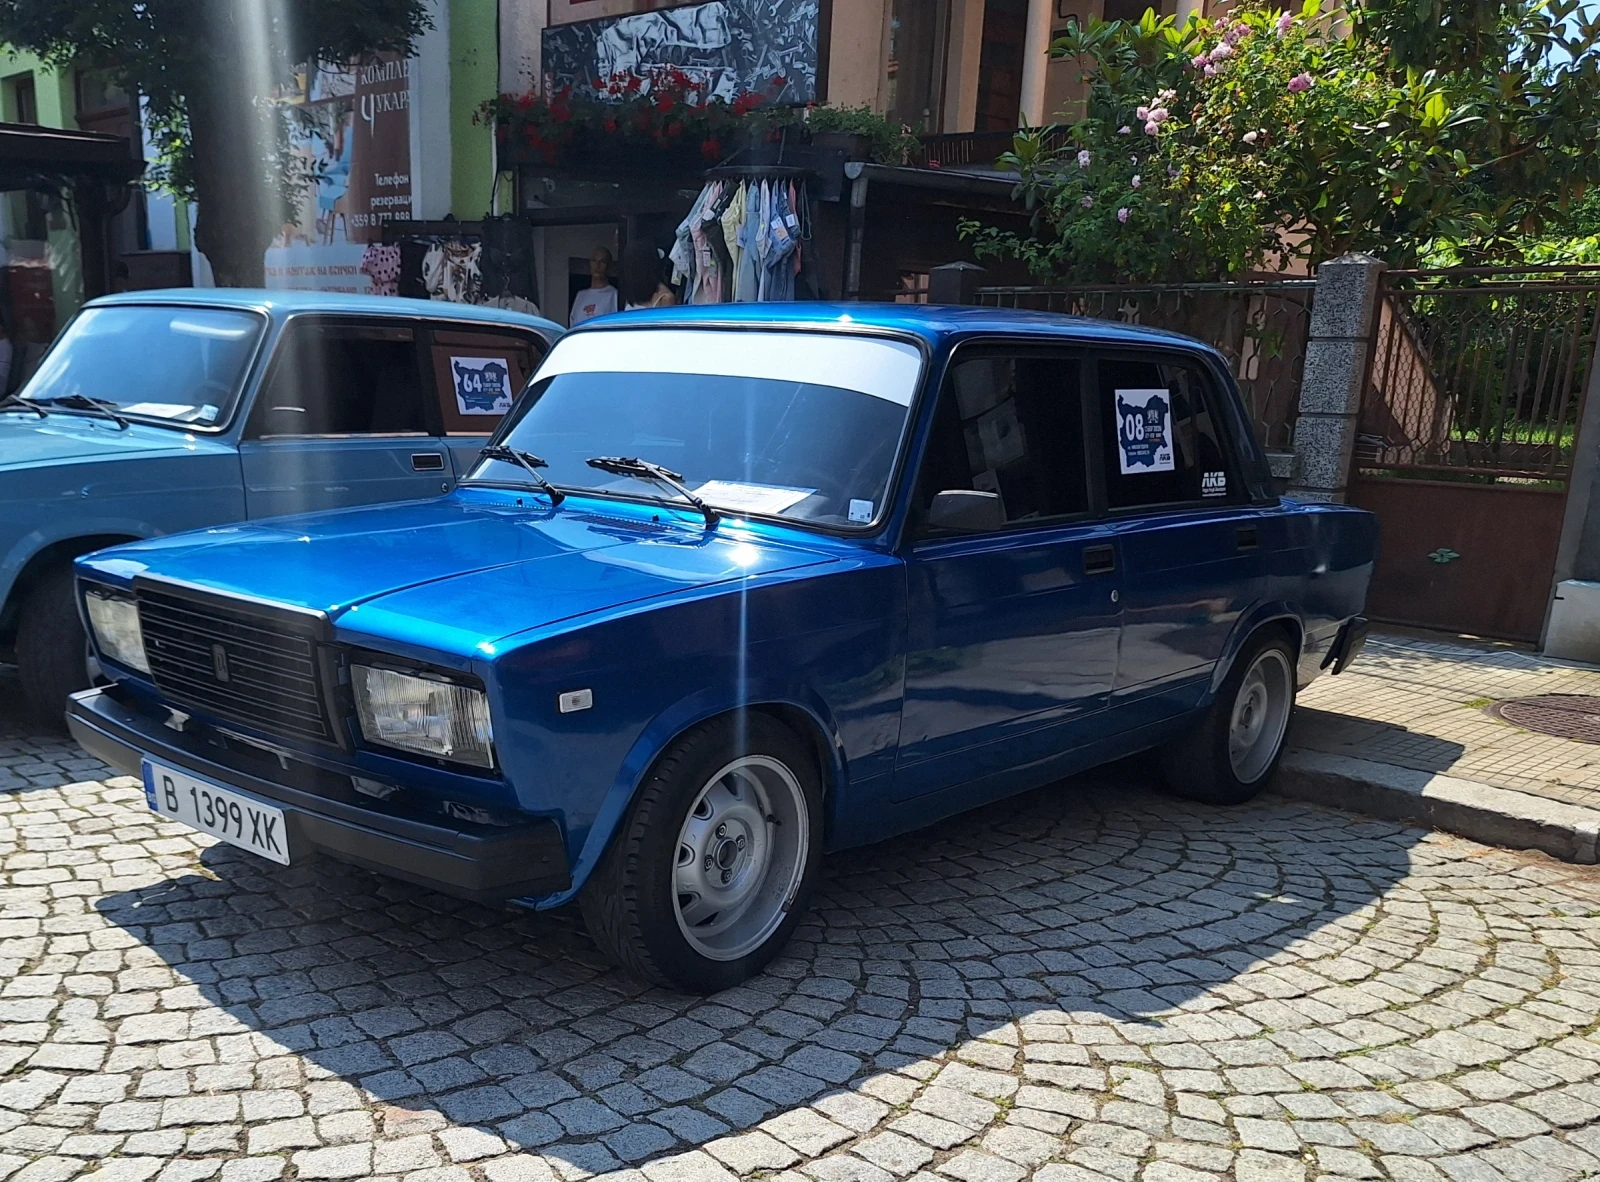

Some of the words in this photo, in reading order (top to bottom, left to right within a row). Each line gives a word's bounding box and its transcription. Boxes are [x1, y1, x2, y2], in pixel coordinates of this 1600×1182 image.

[374, 172, 409, 188] Телефон
[463, 373, 482, 393] 64
[1125, 413, 1144, 441] 08
[162, 774, 179, 813] B
[190, 786, 242, 839] 1399
[247, 807, 282, 855] XK
